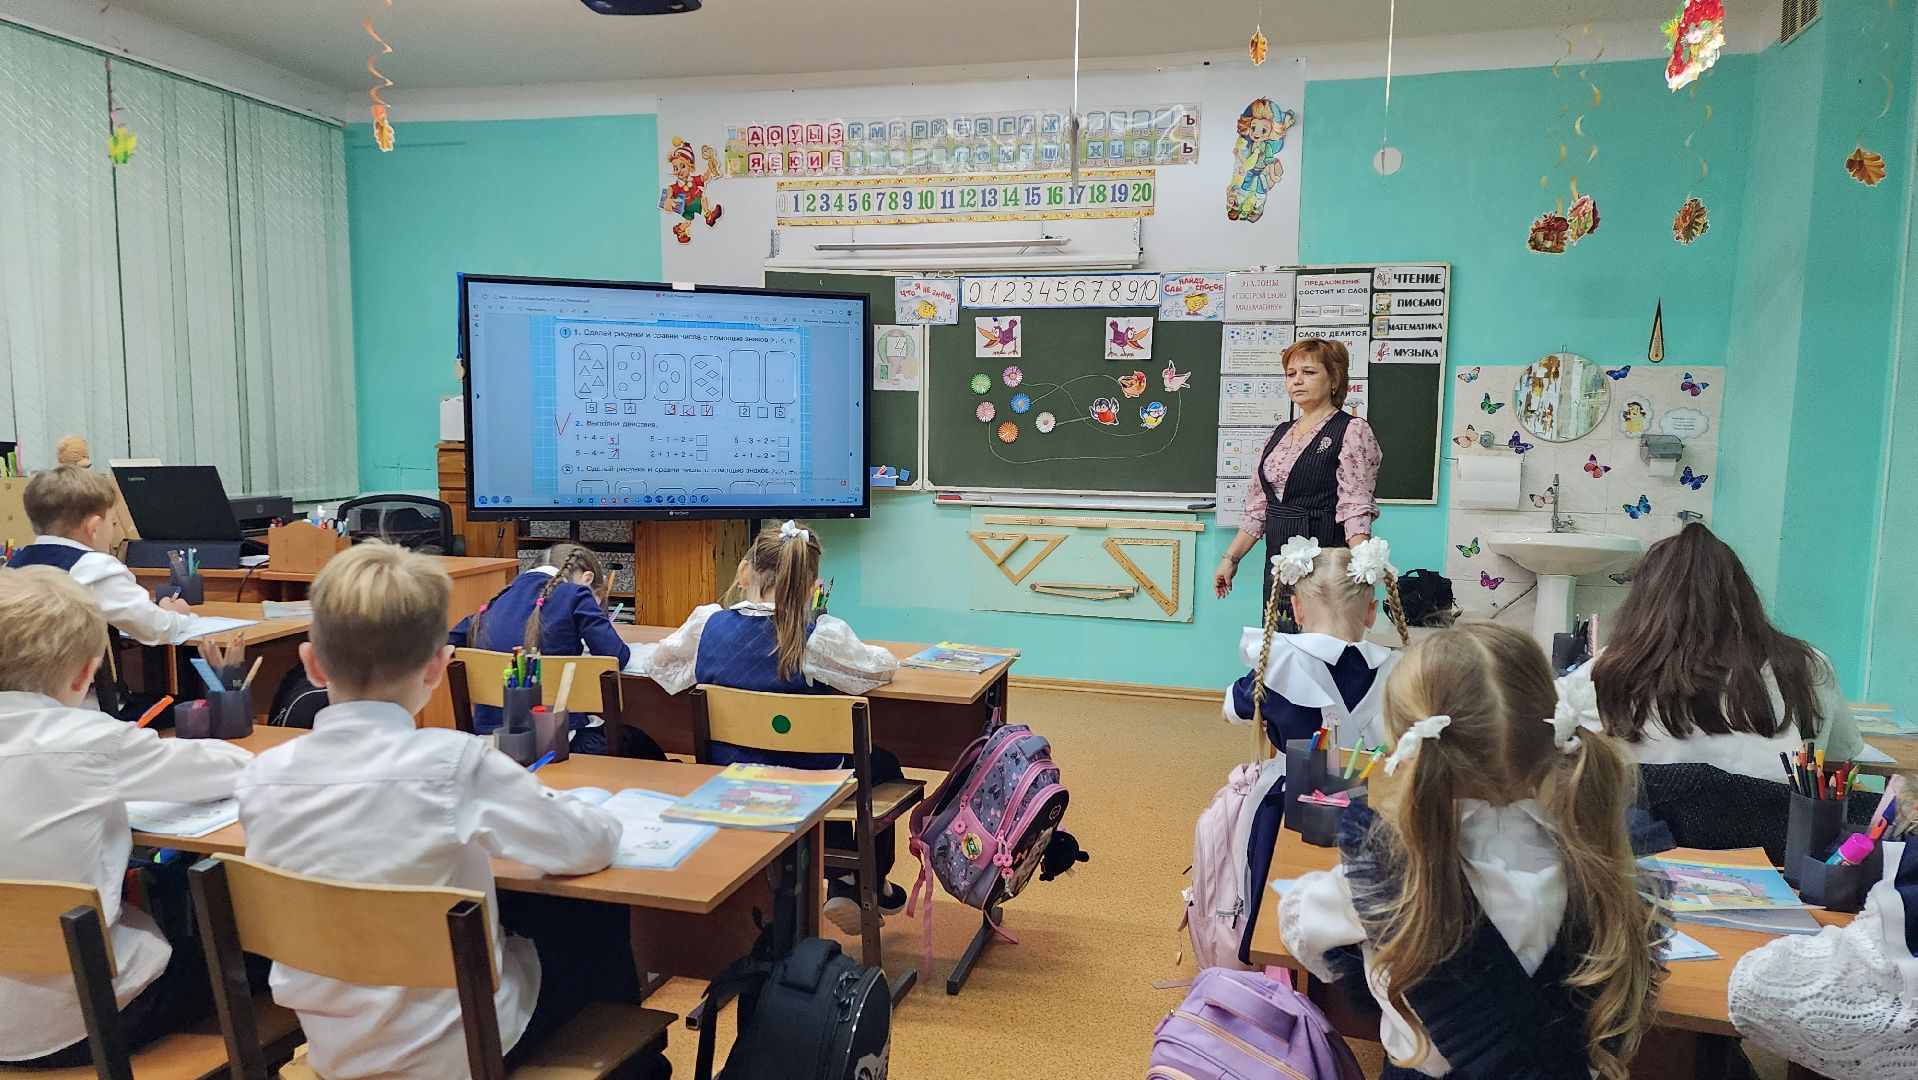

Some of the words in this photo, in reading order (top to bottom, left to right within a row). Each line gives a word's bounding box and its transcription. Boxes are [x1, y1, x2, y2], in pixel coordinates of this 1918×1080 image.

[1090, 145, 1102, 157] Х
[793, 194, 800, 212] 1
[806, 194, 817, 213] 2
[819, 194, 830, 212] 3
[832, 193, 844, 212] 4
[848, 193, 858, 212] 5
[861, 193, 871, 211] 6
[876, 192, 886, 211] 7
[888, 191, 899, 211] 8
[902, 191, 913, 210] 9
[917, 190, 935, 210] 10
[940, 189, 956, 209] 11
[959, 188, 977, 208] 12
[980, 187, 998, 207] 13
[1002, 186, 1020, 207] 14
[1024, 186, 1041, 206] 15
[1046, 186, 1063, 205] 16
[1068, 184, 1087, 204] 17
[1088, 183, 1107, 204] 18
[1110, 183, 1129, 203] 19
[1132, 182, 1152, 203] 20
[1393, 273, 1442, 284] ЧТЕНИЕ
[900, 289, 916, 298] ЧТО
[922, 286, 931, 294] НЕ
[969, 281, 981, 303] 0
[990, 281, 998, 303] 1
[1003, 281, 1016, 303] 2
[1021, 281, 1033, 303] 3
[1039, 281, 1050, 303] 4
[1055, 280, 1068, 302] 5
[1073, 280, 1086, 301] 6
[1092, 280, 1103, 301] 7
[1109, 280, 1122, 301] 8
[1126, 279, 1139, 301] 9
[1139, 279, 1158, 301] 10
[1164, 284, 1183, 293] САМ
[1195, 283, 1224, 292] СПОСОБ
[1299, 288, 1335, 296] СОСТОИТ
[1397, 298, 1442, 308] ПИСЬМО
[1388, 322, 1443, 331] МАТЕМАТИКА
[1329, 330, 1368, 338] ДЕЛИТСЯ
[894, 337, 907, 355] 4
[1393, 348, 1439, 357] МУЗЫКА
